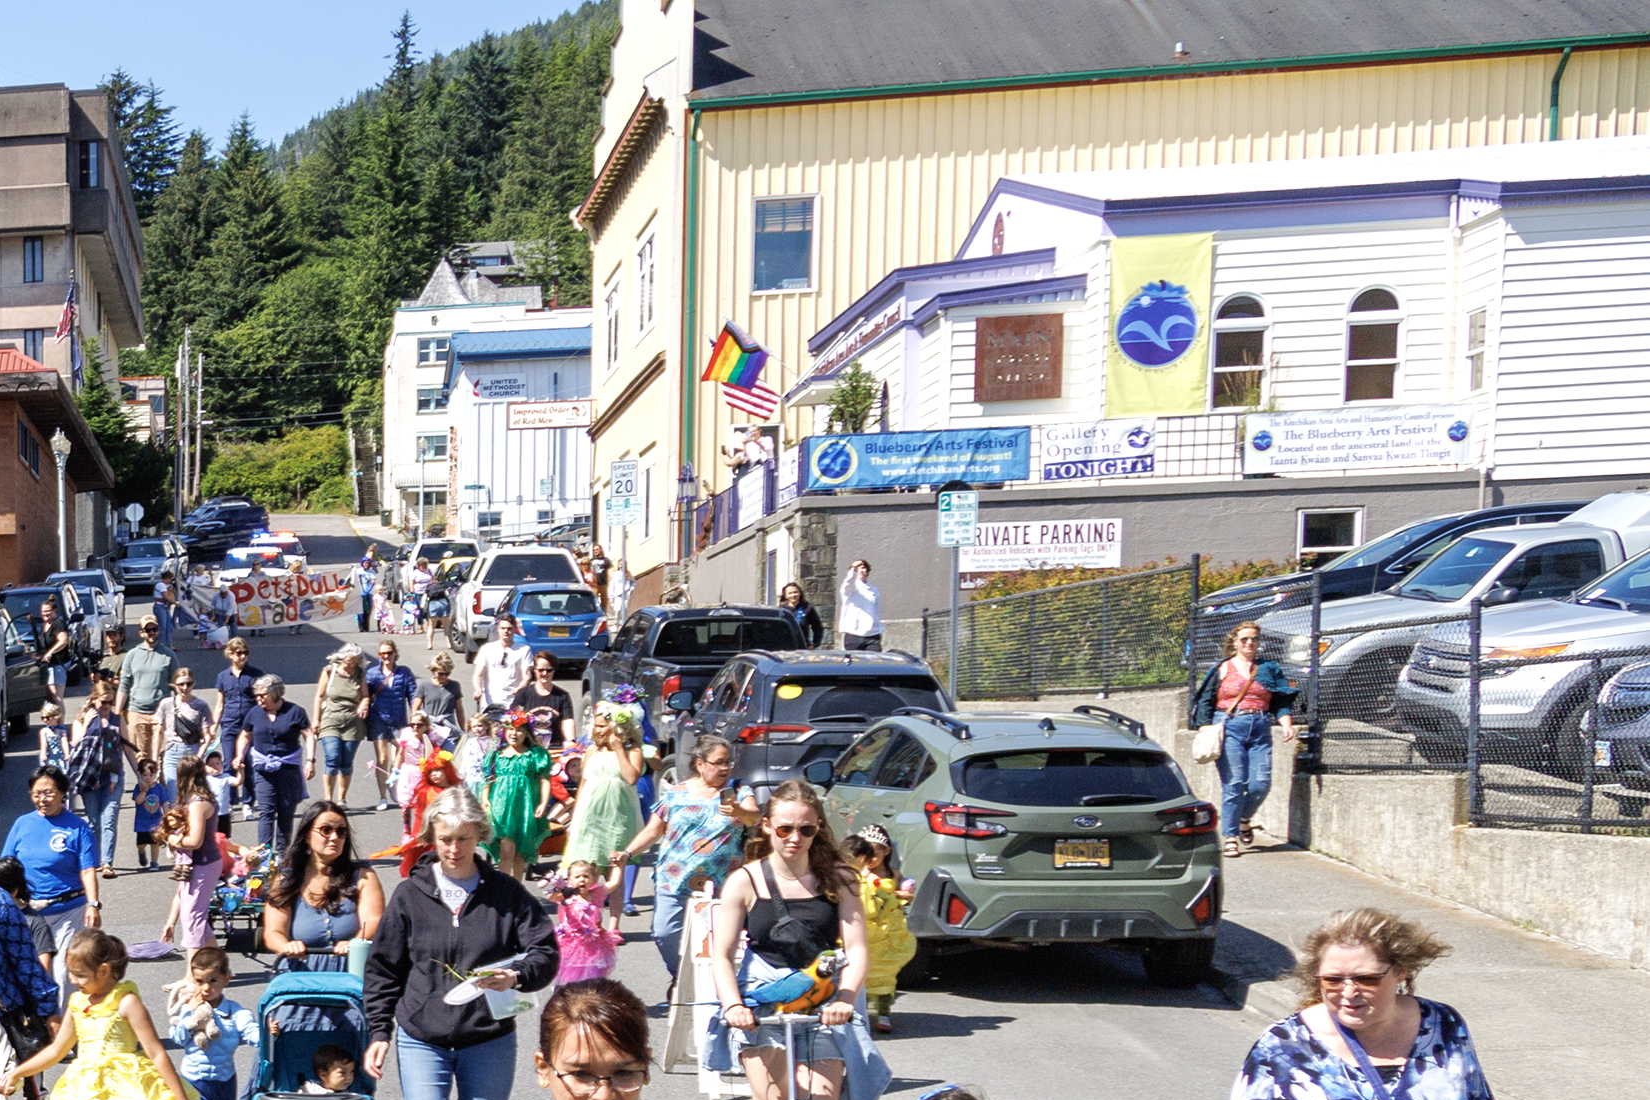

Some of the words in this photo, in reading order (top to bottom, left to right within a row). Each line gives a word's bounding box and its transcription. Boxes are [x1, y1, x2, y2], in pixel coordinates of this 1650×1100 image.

[482, 383, 526, 391] METHODIST
[513, 407, 547, 416] Improved
[548, 406, 570, 414] Order
[513, 418, 521, 426] of
[522, 417, 536, 425] Red
[1046, 427, 1110, 442] Gallery
[1283, 430, 1304, 441] The
[1307, 428, 1363, 441] Blueberry
[1366, 426, 1391, 437] Arts
[1394, 423, 1438, 436] Festival
[865, 442, 932, 455] Blueberry
[935, 440, 963, 451] Arts
[967, 437, 1019, 449] Festival
[1046, 443, 1122, 461] Opening
[1278, 443, 1314, 454] Located
[1331, 442, 1346, 451] the
[1348, 440, 1389, 451] ancestral
[1391, 438, 1412, 448] land
[1415, 437, 1424, 447] of
[1427, 437, 1442, 446] the
[870, 456, 888, 465] The
[890, 455, 912, 465] first
[913, 453, 957, 464] weekend
[960, 452, 972, 462] of
[973, 451, 1012, 463] August!
[1332, 452, 1350, 463] and
[613, 463, 637, 471] SPEED
[882, 464, 1000, 477] www.KetchikanArts.org
[1045, 456, 1152, 479] TONIGHT!
[615, 471, 633, 479] LIMIT
[615, 479, 634, 494] 20
[941, 495, 950, 510] 2
[975, 525, 1031, 546] RIVATE
[1040, 522, 1116, 545] PARKING
[962, 547, 971, 556] for
[973, 546, 1007, 556] Authorized
[1009, 545, 1036, 555] Vehicles
[1038, 545, 1051, 554] with
[1054, 544, 1077, 555] Parking
[1080, 544, 1094, 554] Tags
[1097, 543, 1115, 552] ONLY!
